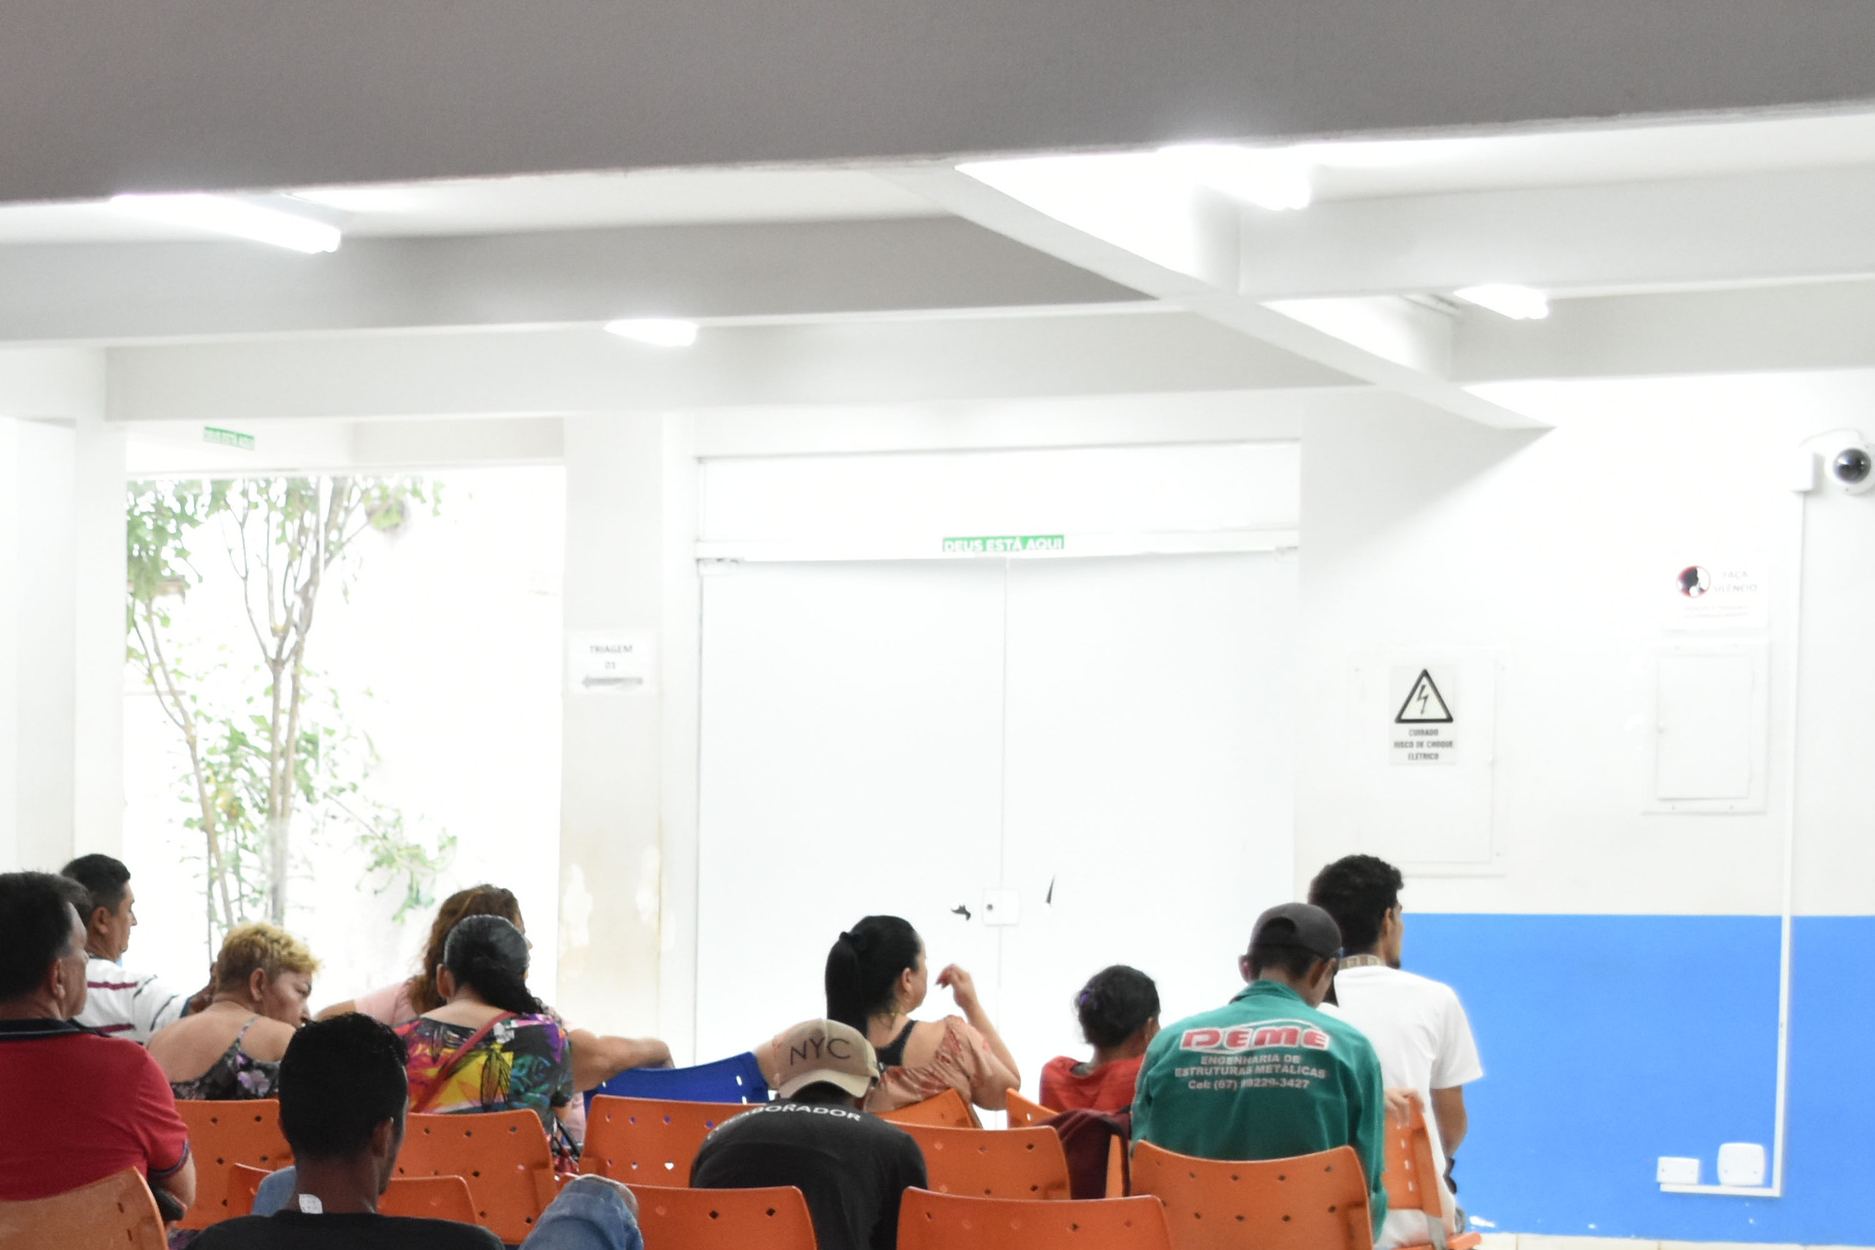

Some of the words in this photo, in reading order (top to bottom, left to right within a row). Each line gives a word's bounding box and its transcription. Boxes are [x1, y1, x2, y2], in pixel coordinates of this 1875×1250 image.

[944, 539, 983, 551] DEUS
[1026, 538, 1062, 549] AQUI
[789, 1037, 851, 1066] NYC
[1201, 1054, 1280, 1065] ENGENHARIA
[1284, 1054, 1301, 1064] DE
[1175, 1066, 1252, 1077] ESTRUTURAS
